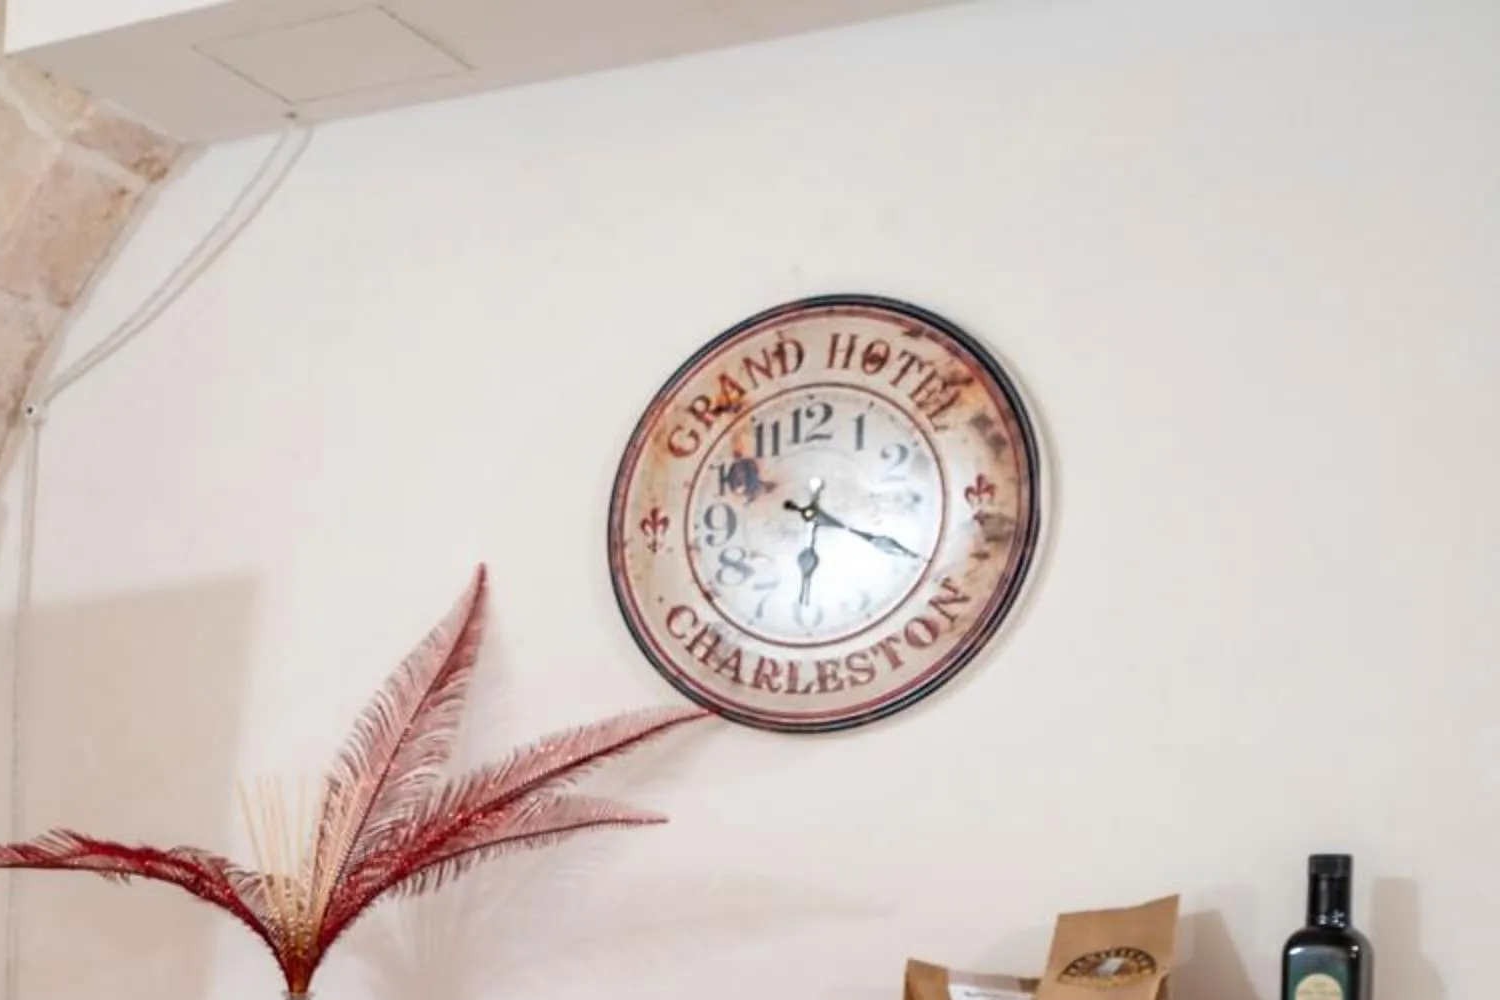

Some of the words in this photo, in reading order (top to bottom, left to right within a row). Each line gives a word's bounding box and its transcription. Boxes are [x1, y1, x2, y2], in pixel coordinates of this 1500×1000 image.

[667, 338, 804, 458] GRAND
[825, 332, 961, 432] HOTEL
[755, 420, 781, 458] 11
[790, 401, 833, 444] 12
[854, 413, 866, 451] 1
[880, 443, 910, 482] 2
[703, 503, 737, 547] 9
[716, 546, 754, 587] 8
[665, 576, 971, 695] CHARLESTON
